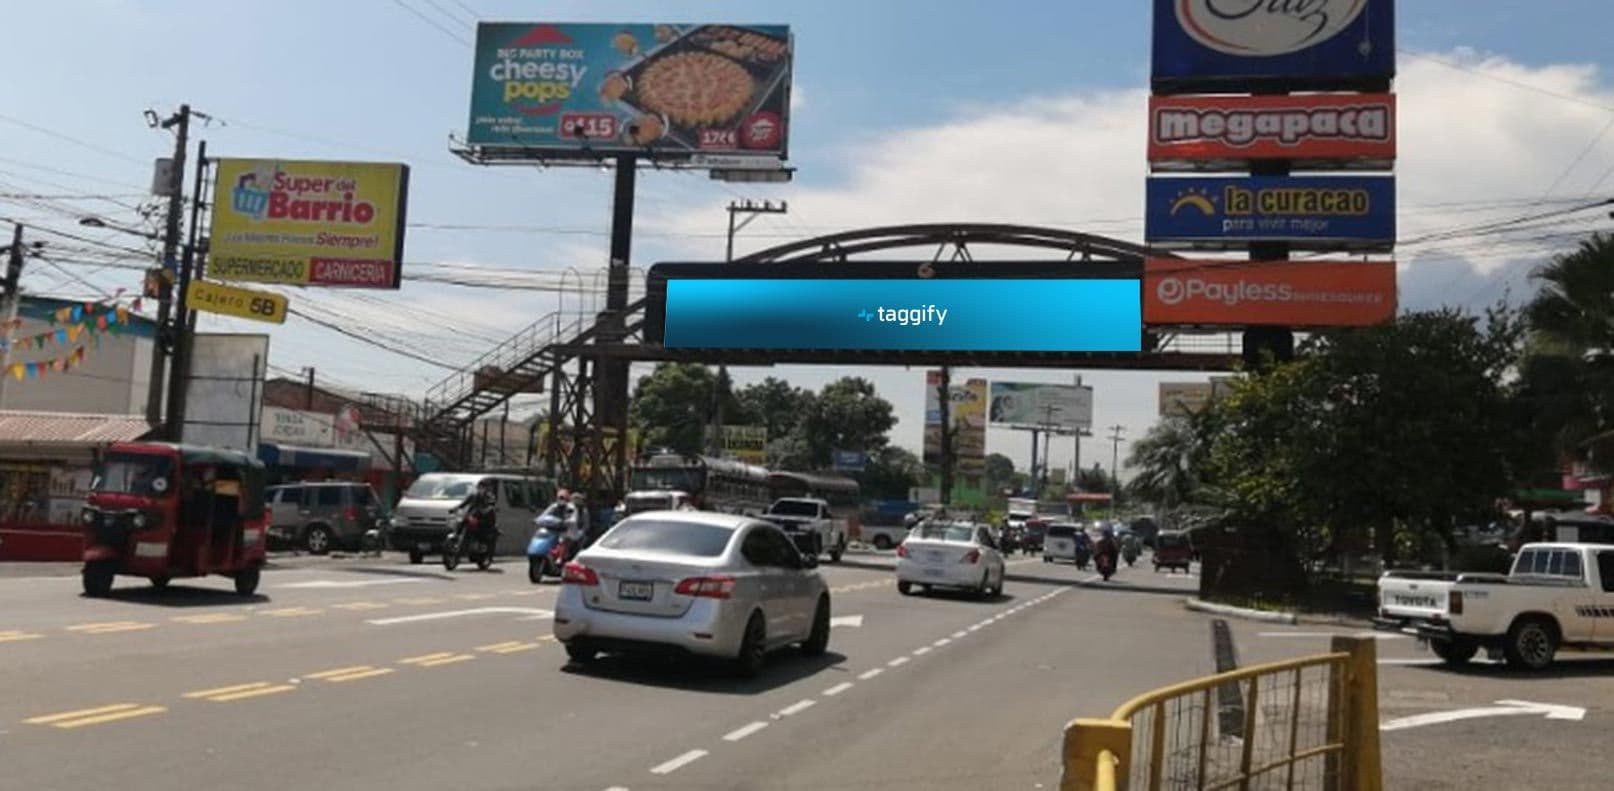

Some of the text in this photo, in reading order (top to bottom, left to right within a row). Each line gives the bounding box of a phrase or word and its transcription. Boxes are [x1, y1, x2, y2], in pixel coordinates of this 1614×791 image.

[519, 48, 557, 58] PARTY
[559, 48, 584, 58] BOX
[489, 58, 588, 88] cheesy
[503, 80, 571, 103] pops
[1159, 109, 1386, 144] megapaca
[274, 173, 356, 196] Super del
[267, 192, 375, 224] Barrio
[1225, 187, 1369, 214] la curacao
[1222, 217, 1329, 234] para vivir mejor
[315, 231, 379, 249] Siempre!
[212, 256, 305, 279] SUPERMERCADO
[194, 288, 274, 316] Cajero 5B
[1186, 279, 1293, 305] Payless
[877, 304, 947, 326] taggify
[1395, 594, 1438, 607] TOYOTA
